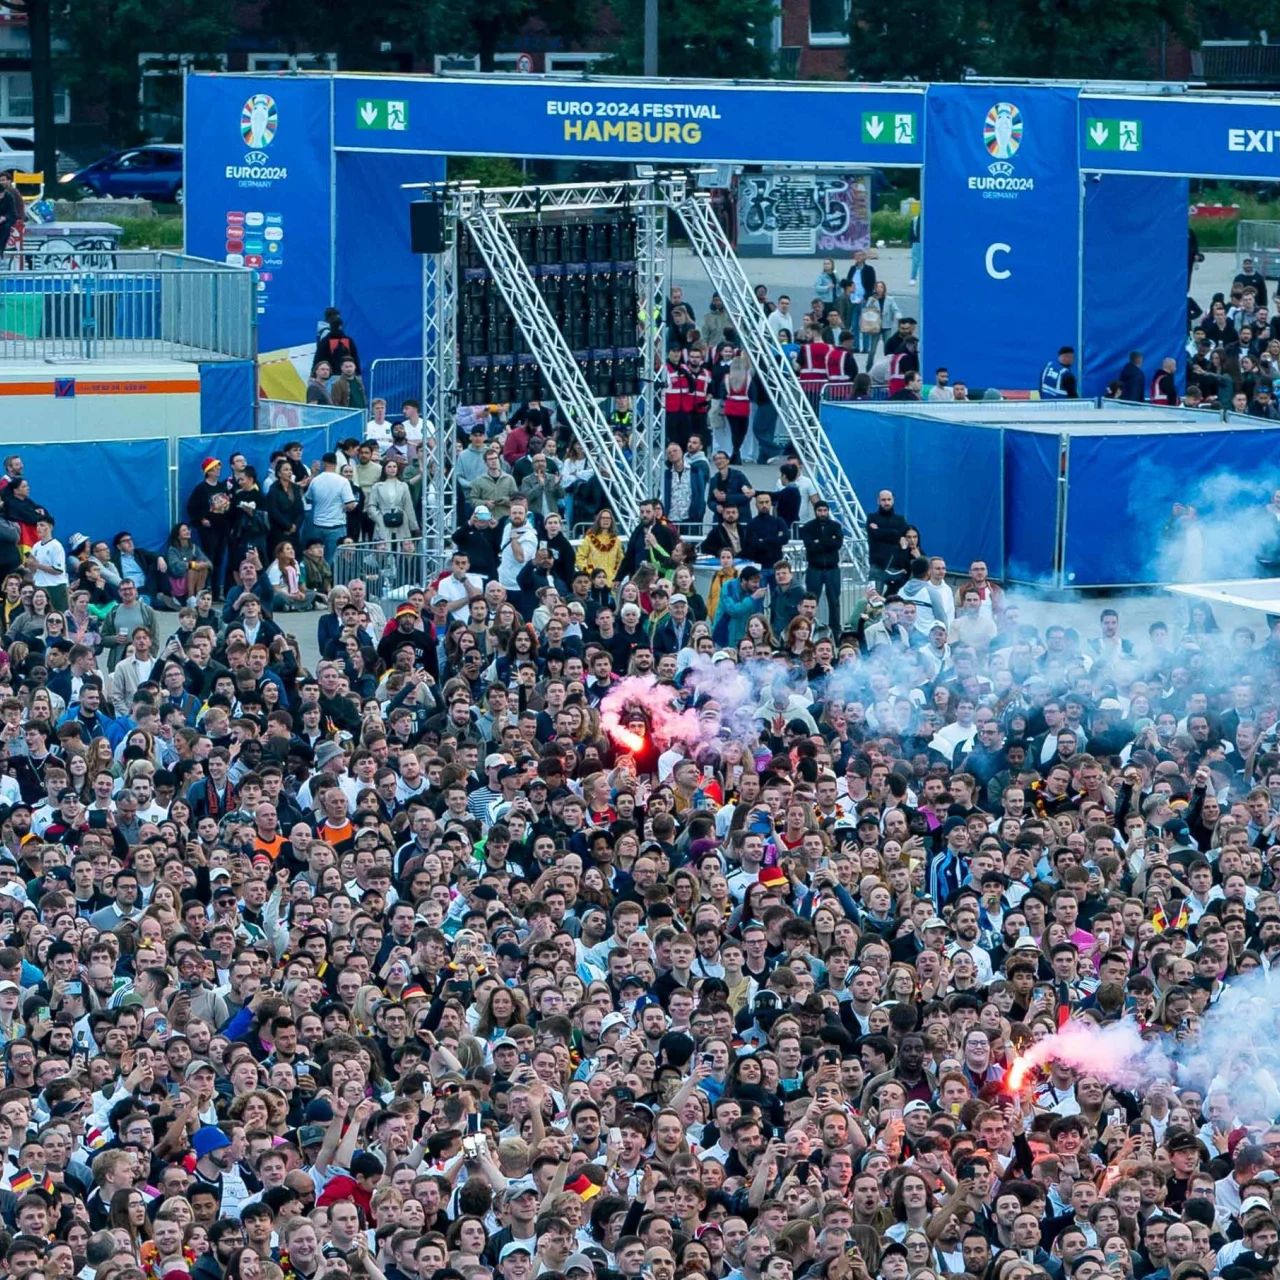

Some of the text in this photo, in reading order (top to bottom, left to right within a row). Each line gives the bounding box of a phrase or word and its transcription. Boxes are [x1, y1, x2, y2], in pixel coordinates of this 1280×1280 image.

[546, 101, 721, 119] EURO 2024 FESTIVAL
[564, 119, 702, 144] HAMBURG
[225, 166, 287, 179] EURO2024
[968, 177, 1034, 190] EURO2024
[985, 242, 1012, 280] C
